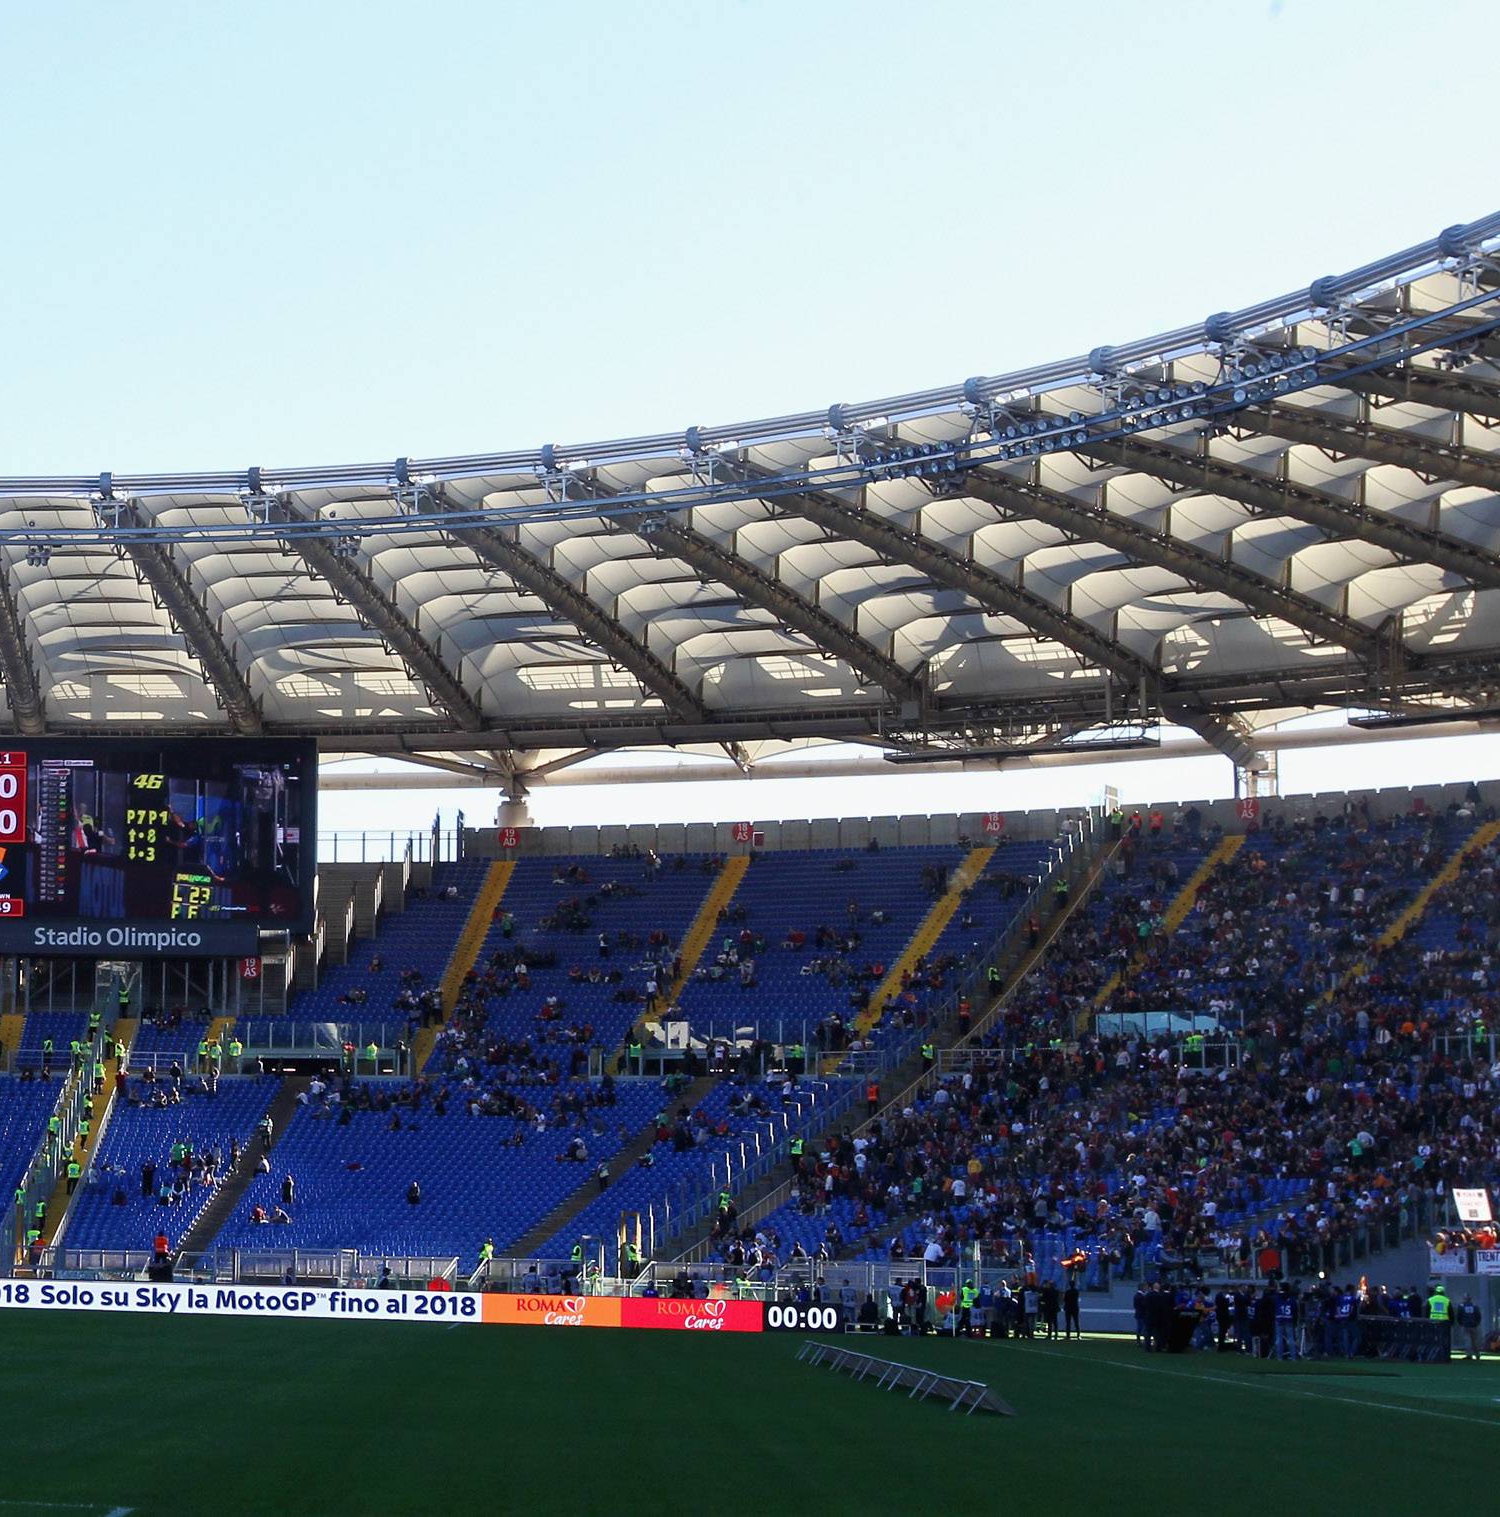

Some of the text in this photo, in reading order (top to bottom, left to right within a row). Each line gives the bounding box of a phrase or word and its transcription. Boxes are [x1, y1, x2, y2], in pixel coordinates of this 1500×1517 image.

[133, 774, 164, 789] 46
[1242, 800, 1252, 809] 17
[988, 813, 998, 822] 18
[1241, 809, 1254, 819] AS
[738, 823, 748, 832] 18
[986, 823, 1000, 831] AD
[505, 828, 515, 837] 19
[736, 832, 749, 841] AS
[503, 837, 516, 846] AD
[34, 926, 201, 951] Stadio Olimpico
[244, 958, 255, 967] 19
[243, 967, 257, 977] AS
[40, 1285, 94, 1306] Solo
[100, 1290, 129, 1307] su
[135, 1287, 181, 1313] Sky
[188, 1288, 209, 1309] la
[328, 1291, 380, 1314] fino
[387, 1293, 408, 1314] al
[414, 1294, 477, 1316] 2018
[516, 1298, 566, 1312] ROMA
[657, 1302, 707, 1316] ROMA
[544, 1311, 584, 1326] Cares
[684, 1315, 724, 1329] Cares
[768, 1305, 837, 1329] 00:00
